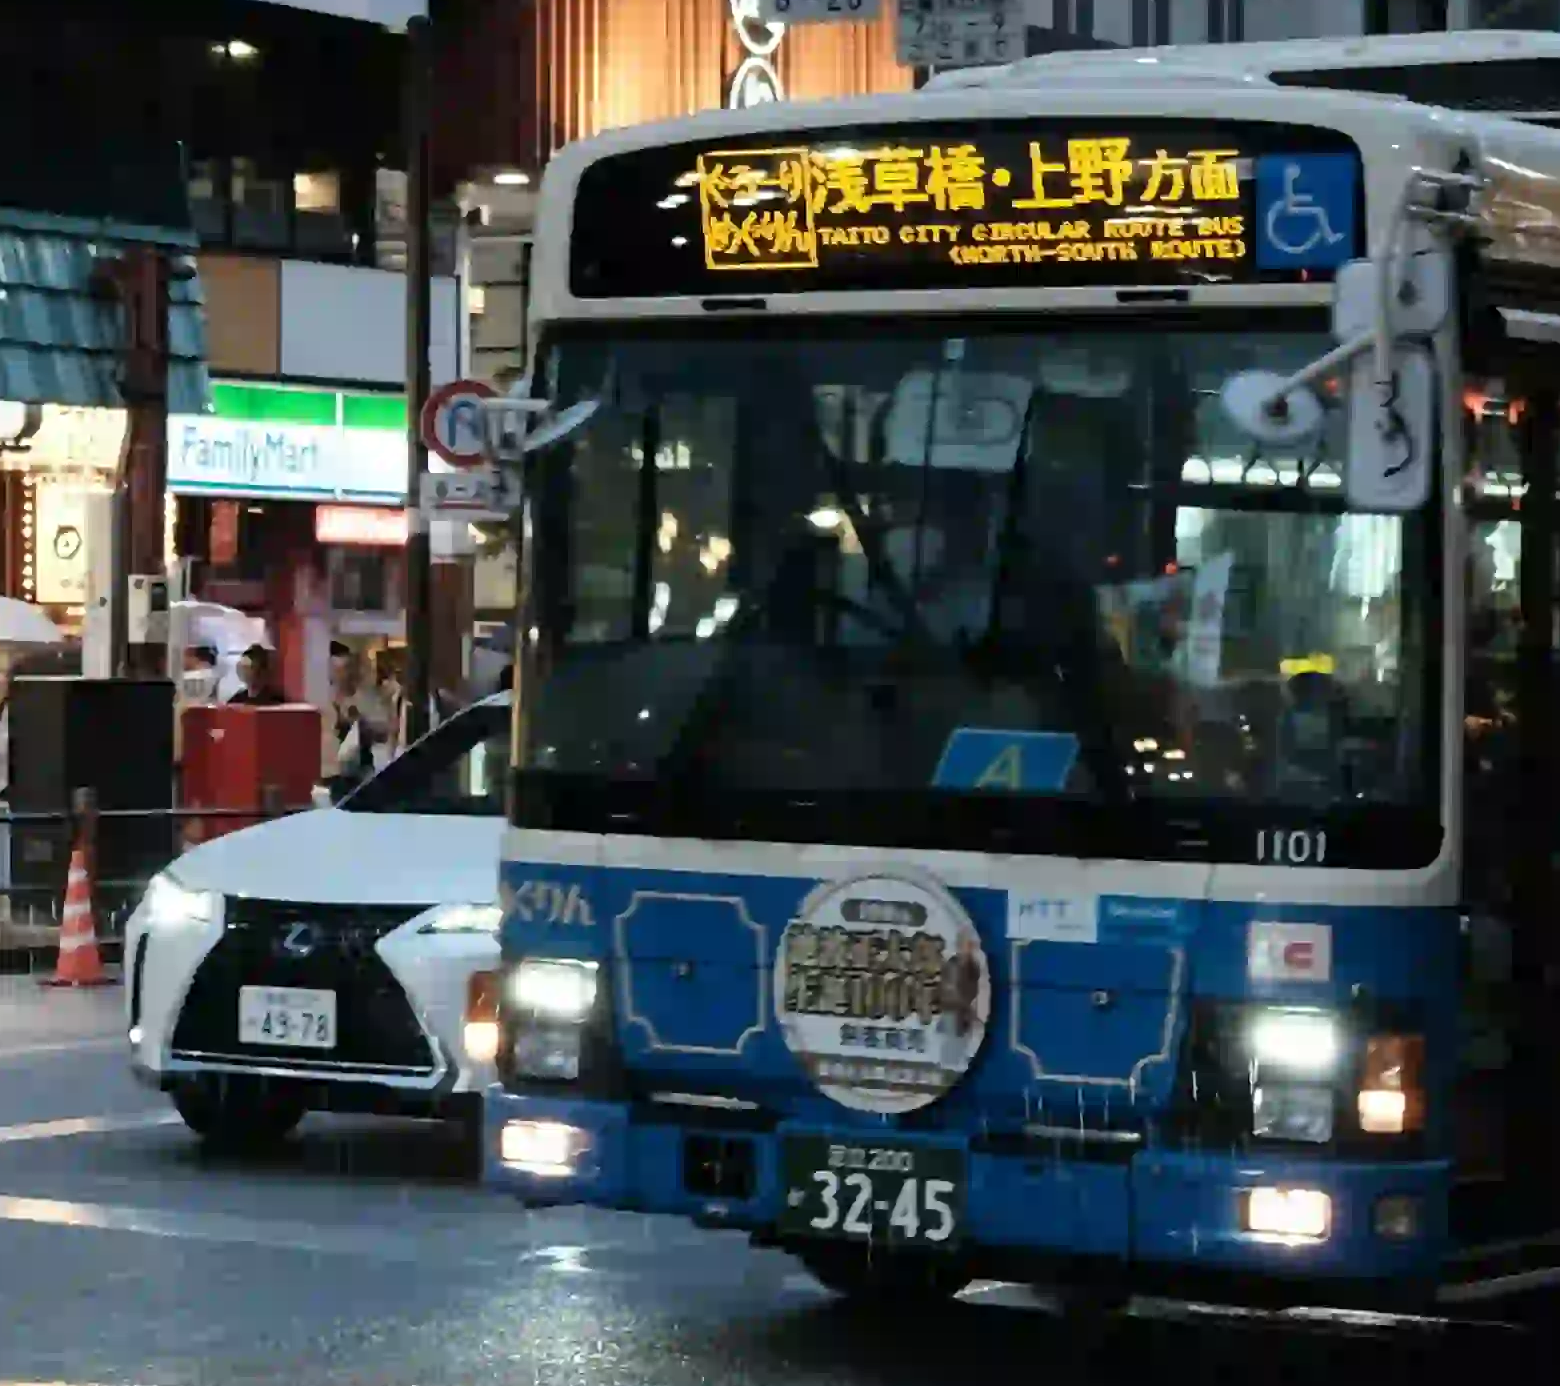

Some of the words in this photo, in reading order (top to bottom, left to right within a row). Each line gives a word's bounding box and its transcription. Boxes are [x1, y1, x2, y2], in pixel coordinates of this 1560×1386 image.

[809, 137, 1240, 214] 浅草橋・上野方面
[820, 225, 890, 246] TAITO
[899, 224, 962, 245] CITY
[971, 219, 1092, 243] CIRCULAR
[1102, 217, 1184, 240] ROUTE
[182, 425, 319, 482] FamilyMart
[1255, 829, 1328, 863] 1101
[809, 1169, 957, 1242] 32-45
